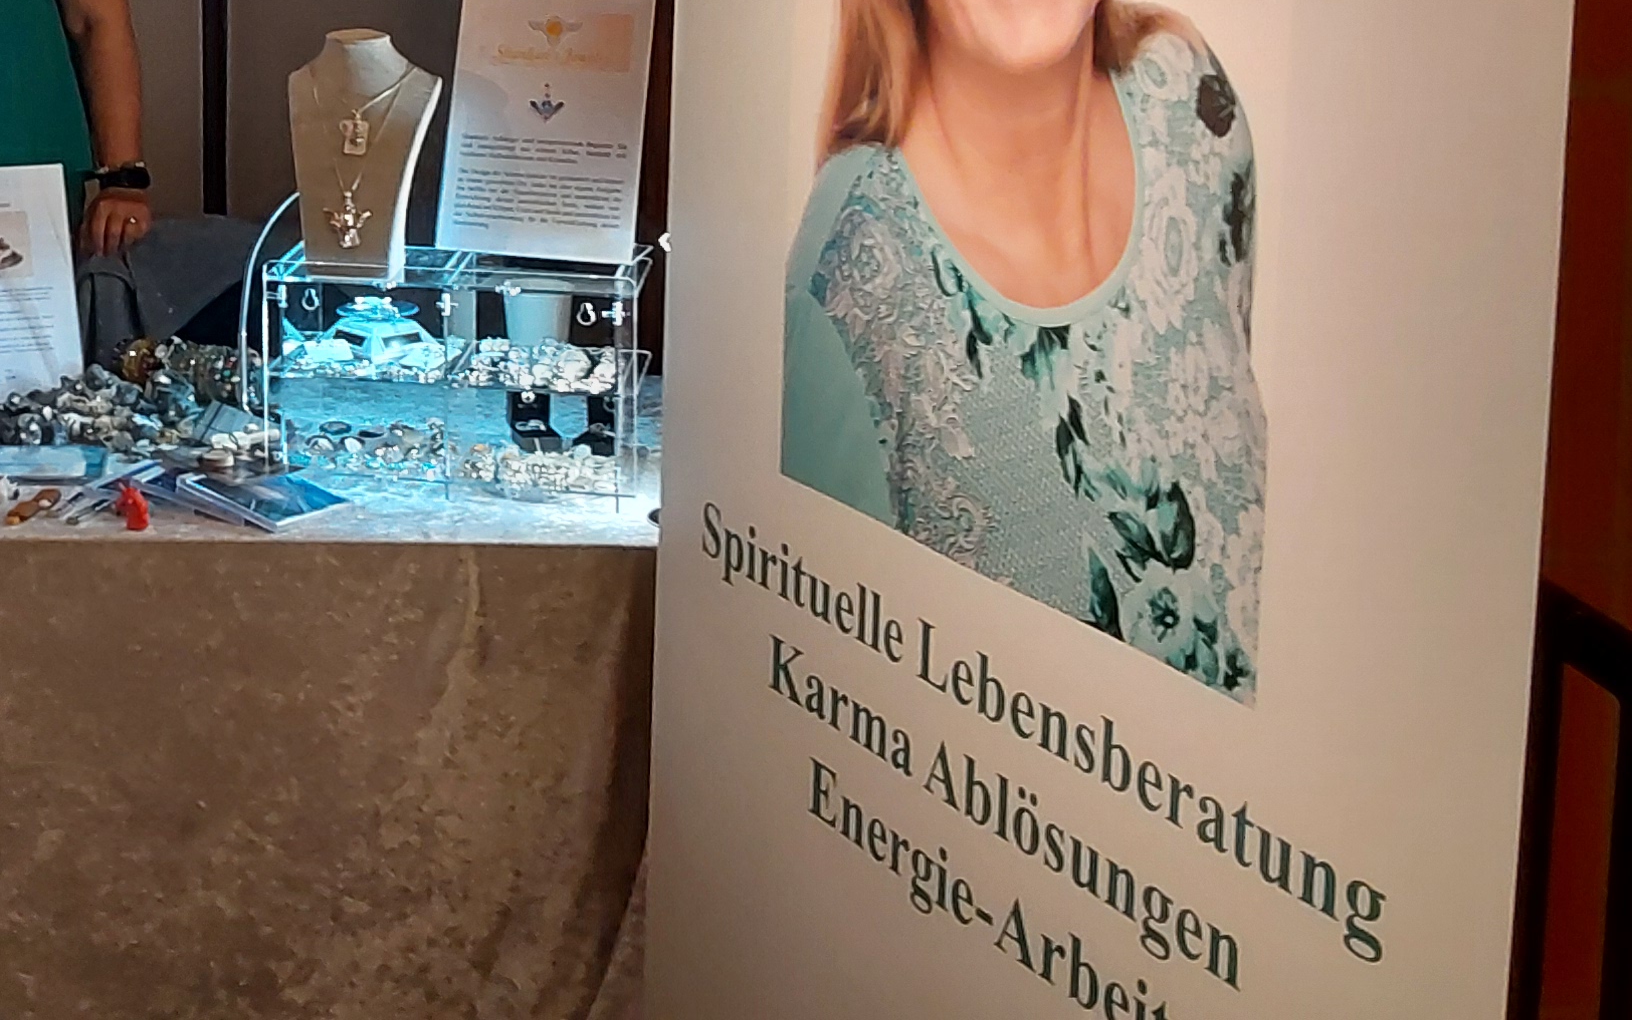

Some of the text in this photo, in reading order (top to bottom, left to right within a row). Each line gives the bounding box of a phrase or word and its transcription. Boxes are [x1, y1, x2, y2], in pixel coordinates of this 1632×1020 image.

[701, 502, 1388, 964] Spirituelle Lebensberatung
[769, 634, 1242, 991] Karma Ablösungen
